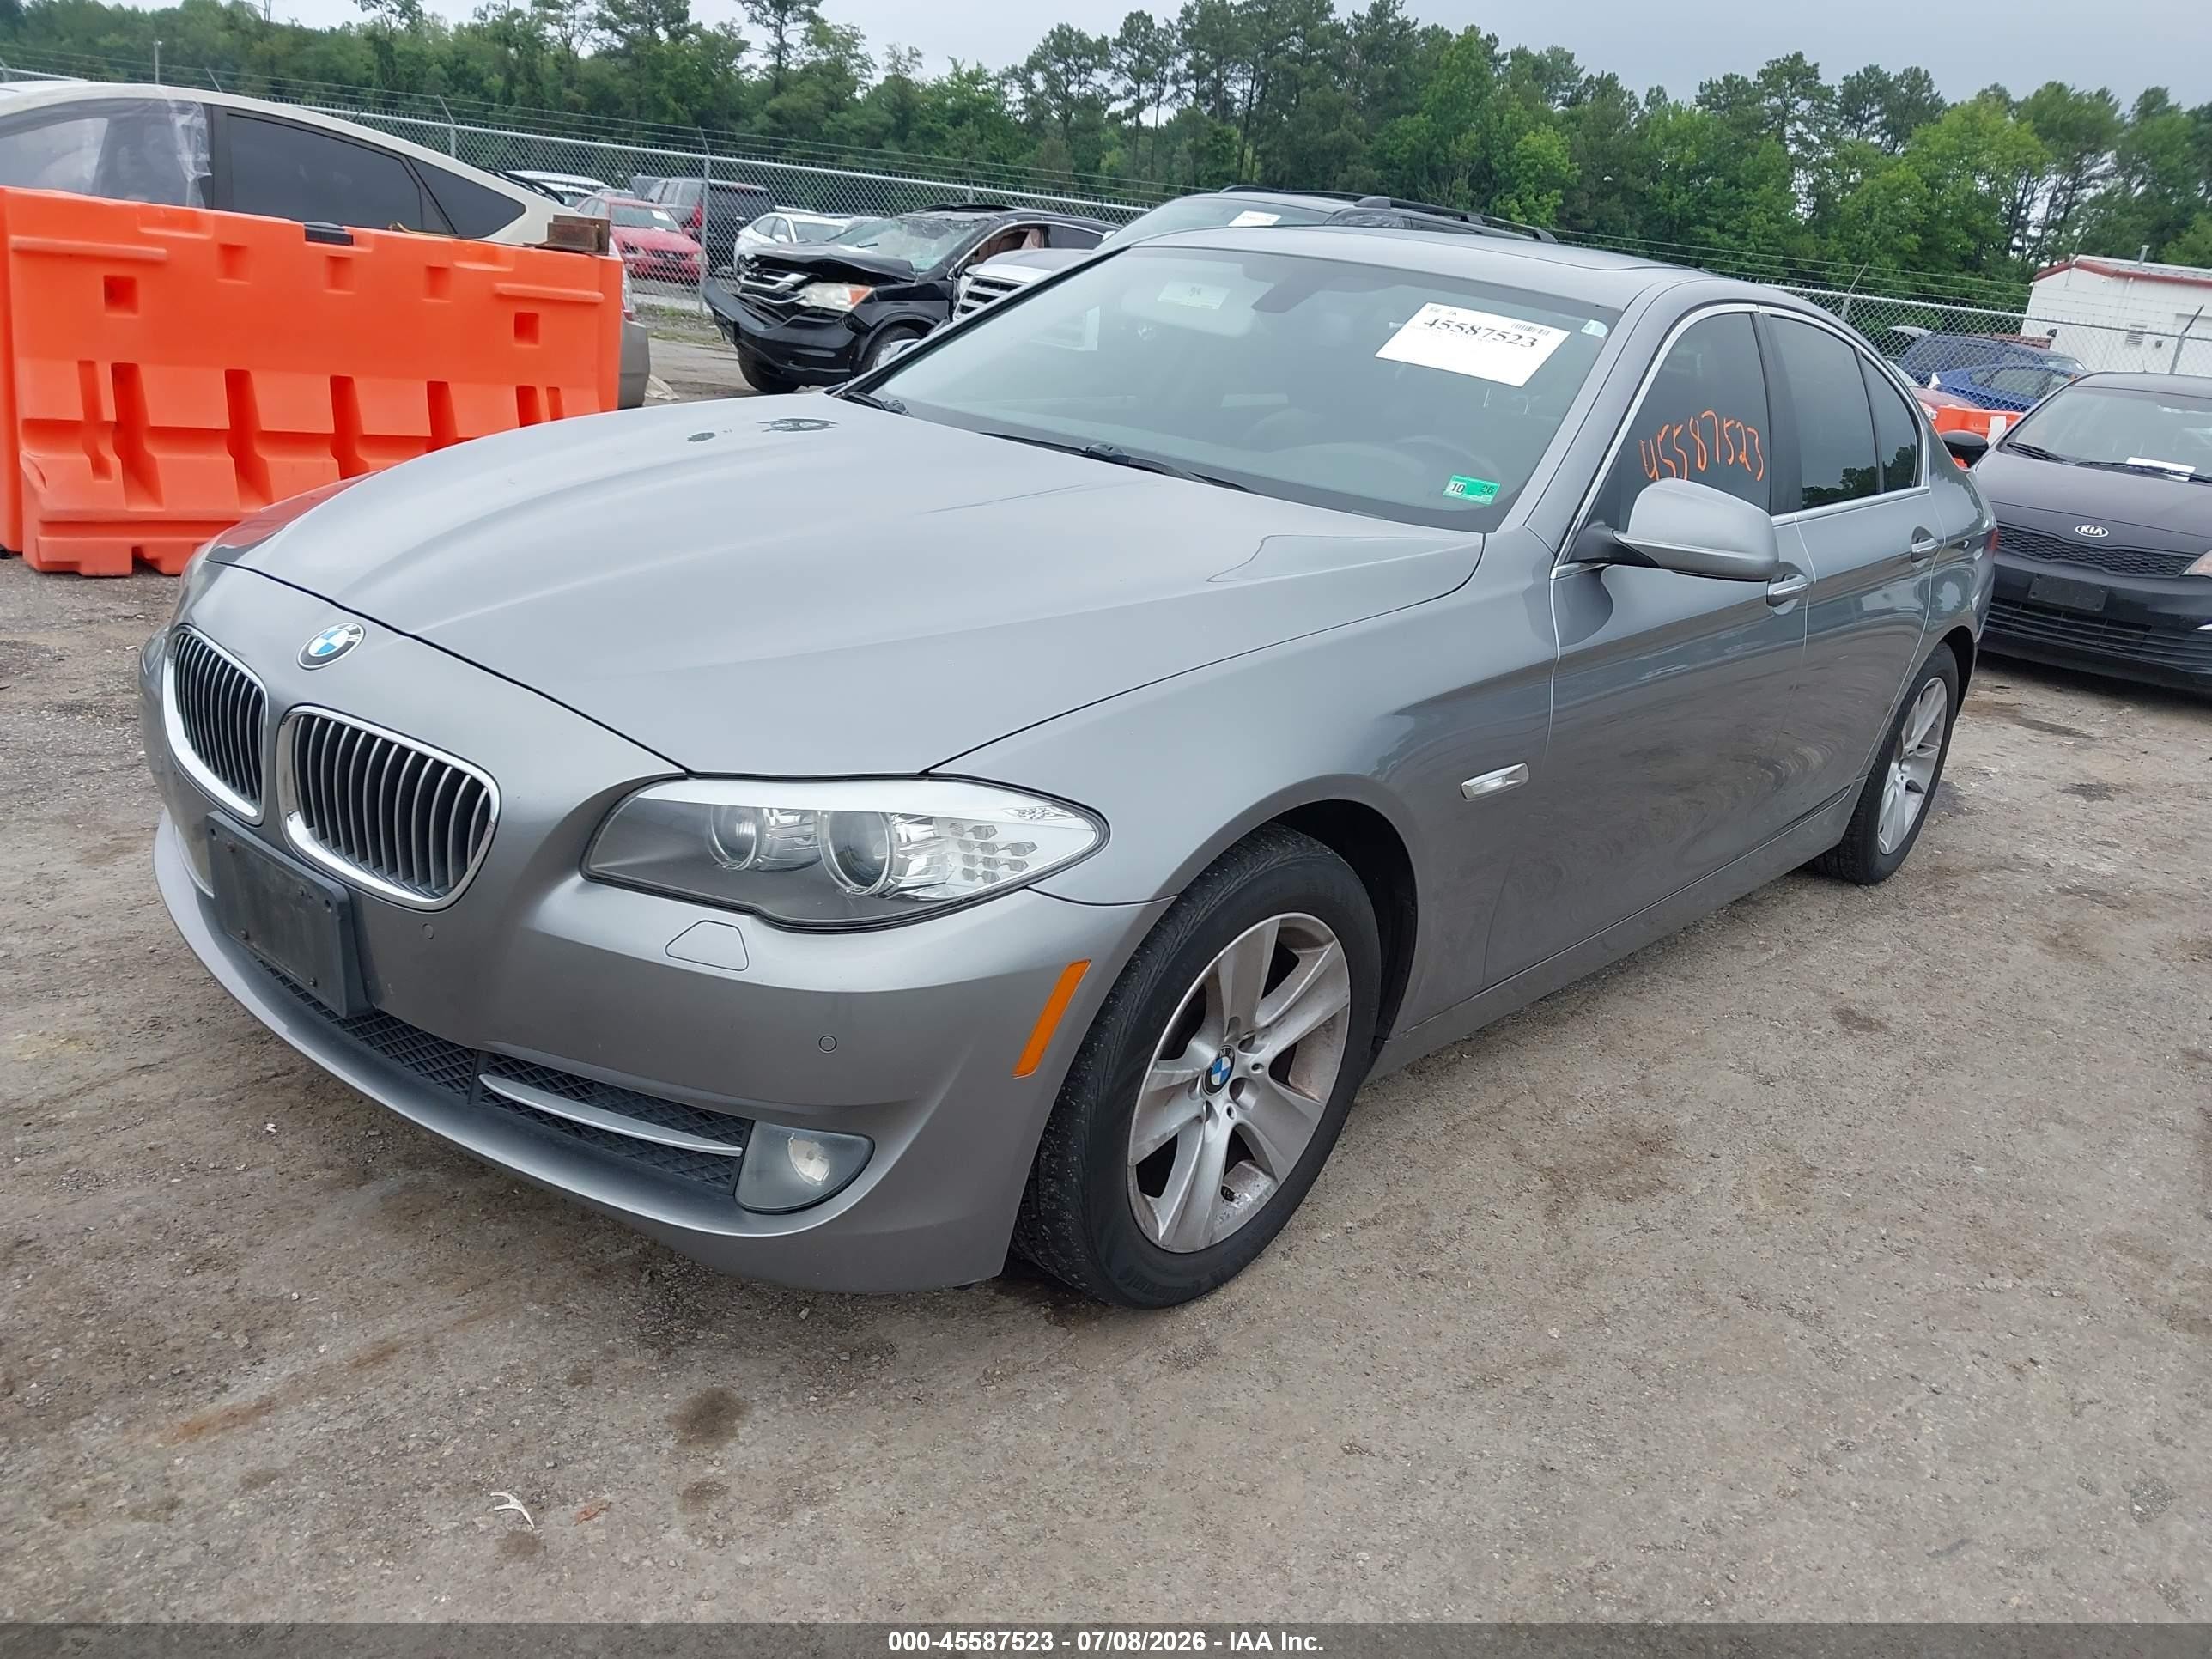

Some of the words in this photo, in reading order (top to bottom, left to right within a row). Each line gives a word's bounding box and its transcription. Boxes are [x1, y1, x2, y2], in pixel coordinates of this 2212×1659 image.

[1424, 318, 1538, 348] 45587523
[1639, 409, 1765, 481] 45587523
[1451, 483, 1466, 494] 10
[2081, 525, 2103, 535] KIA
